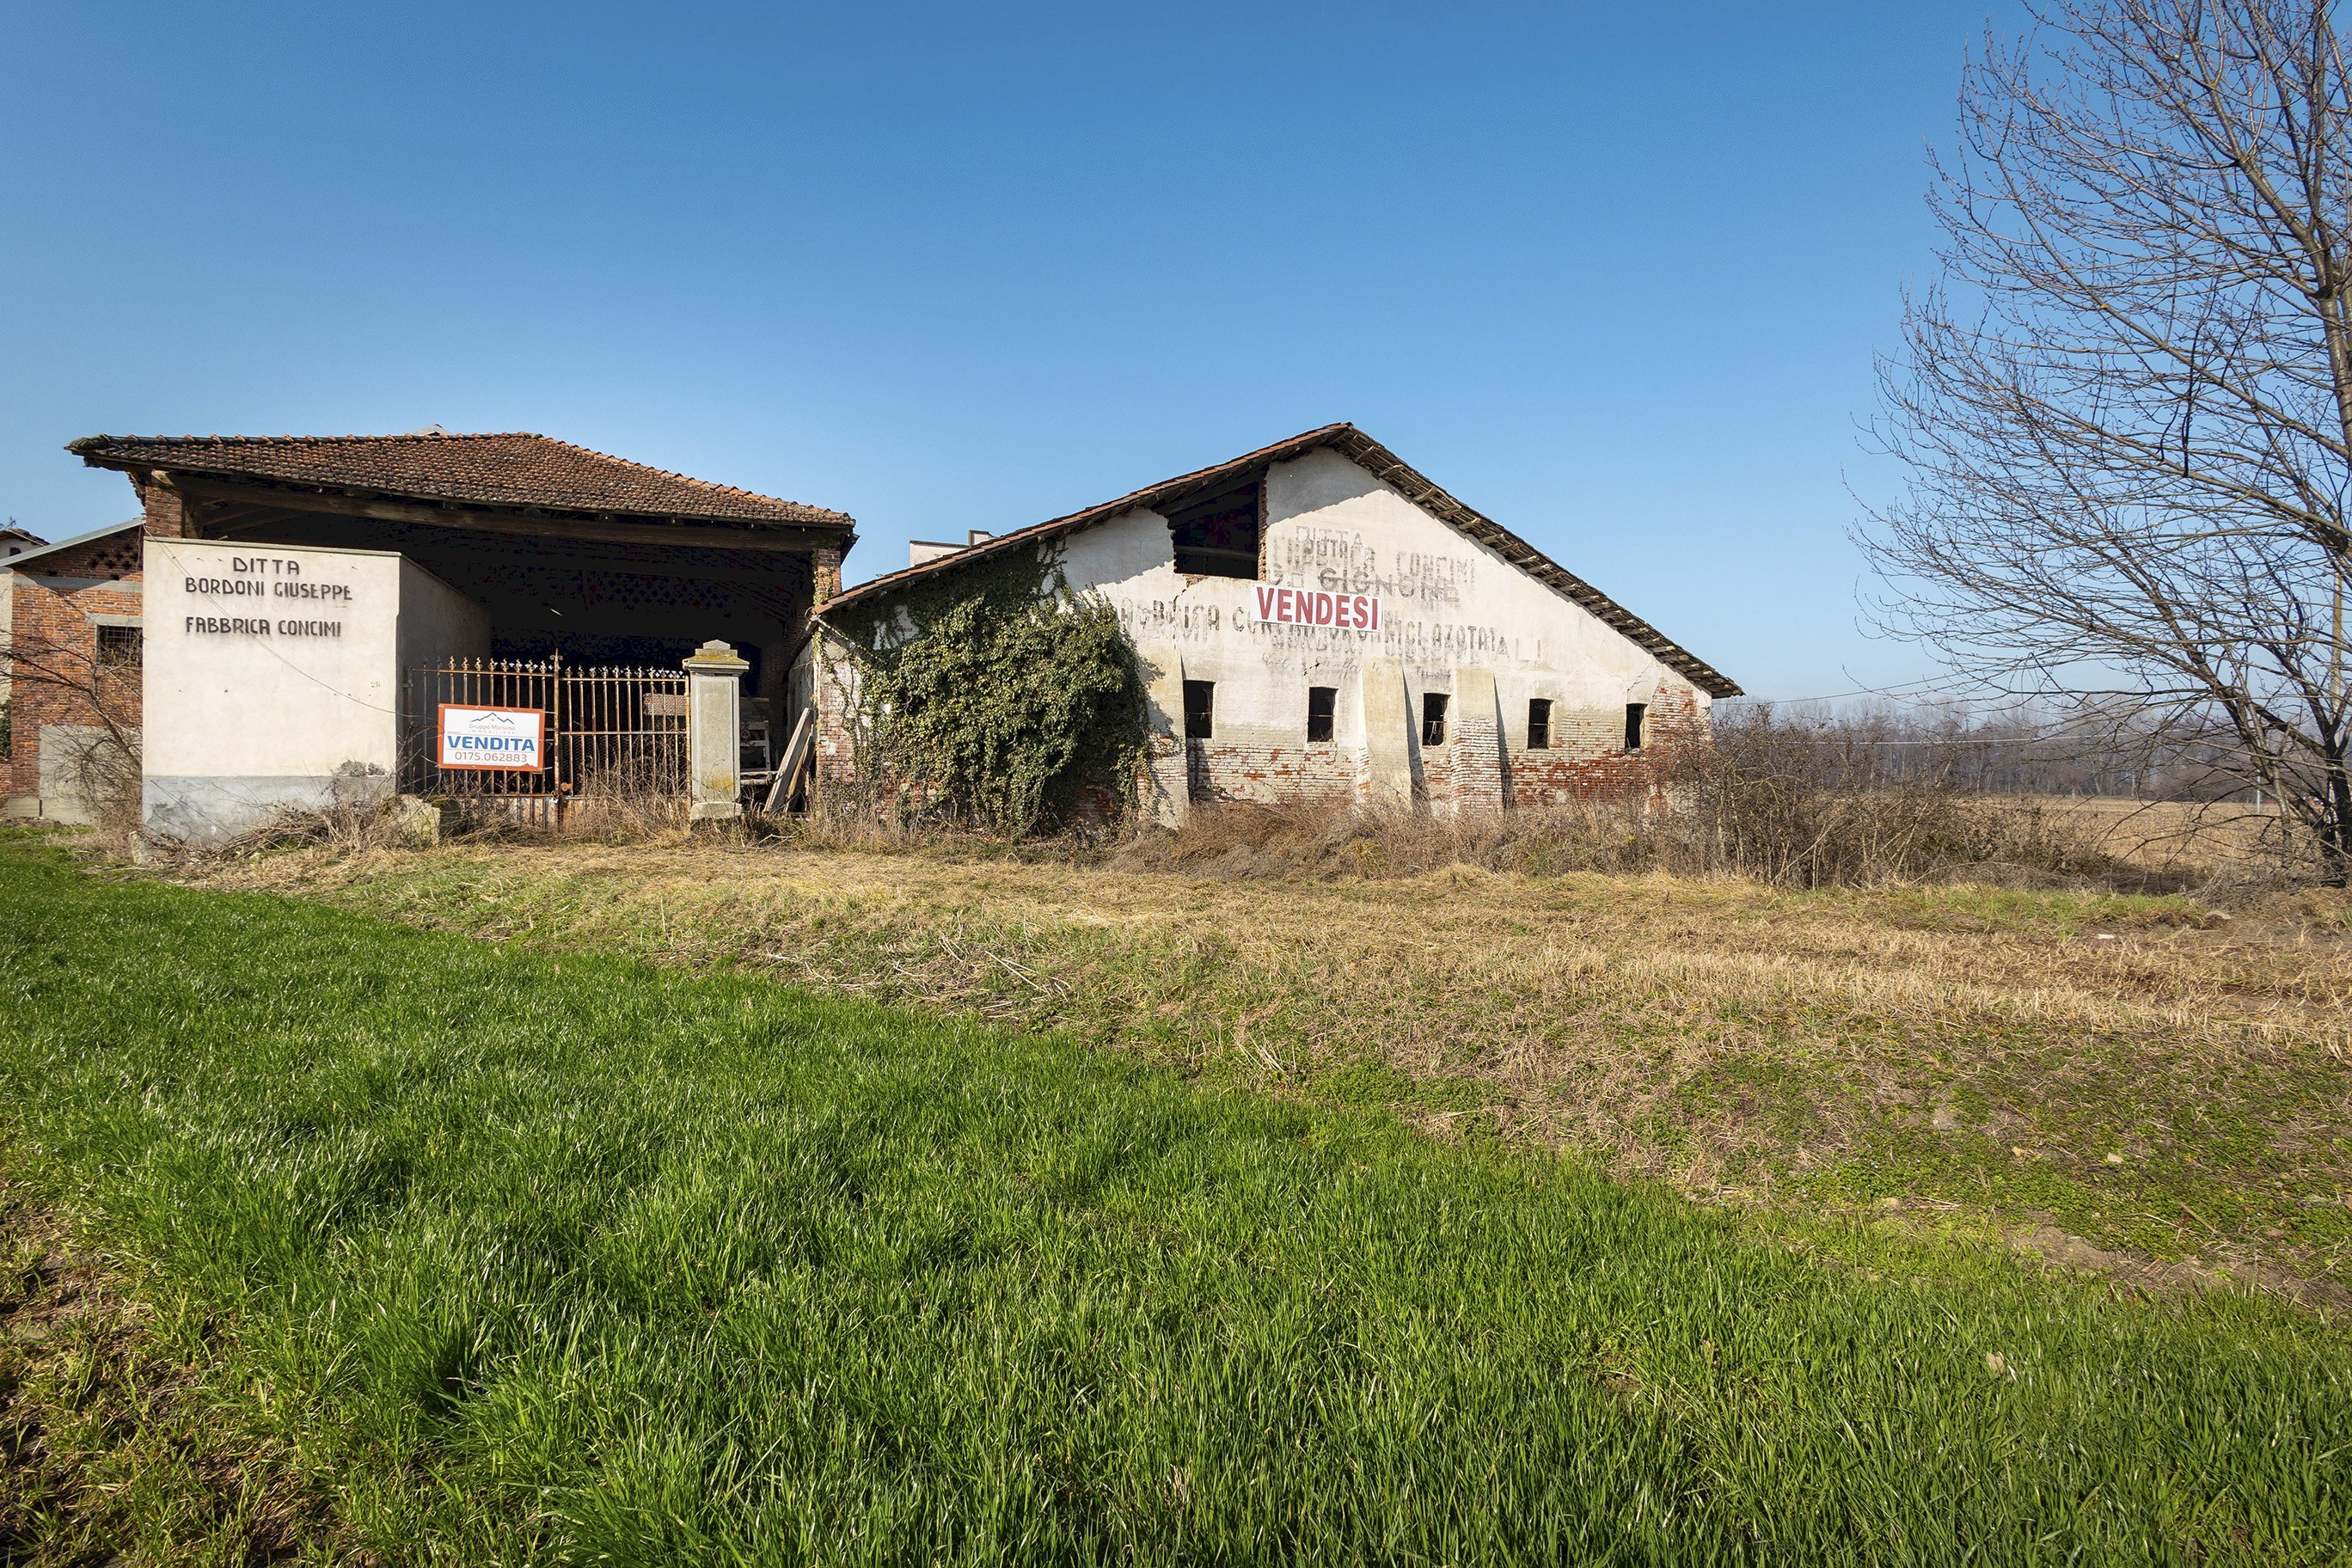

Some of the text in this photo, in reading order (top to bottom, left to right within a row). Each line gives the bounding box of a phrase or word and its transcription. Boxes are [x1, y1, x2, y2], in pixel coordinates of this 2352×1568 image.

[233, 556, 300, 575] DITTA
[185, 577, 352, 601] BORDONI GIUSEPPE
[1256, 586, 1378, 630] VENDESI
[185, 616, 342, 637] FABBRICA CONCIMI
[447, 735, 536, 751] VENDITA
[455, 751, 527, 763] 0175.062883
